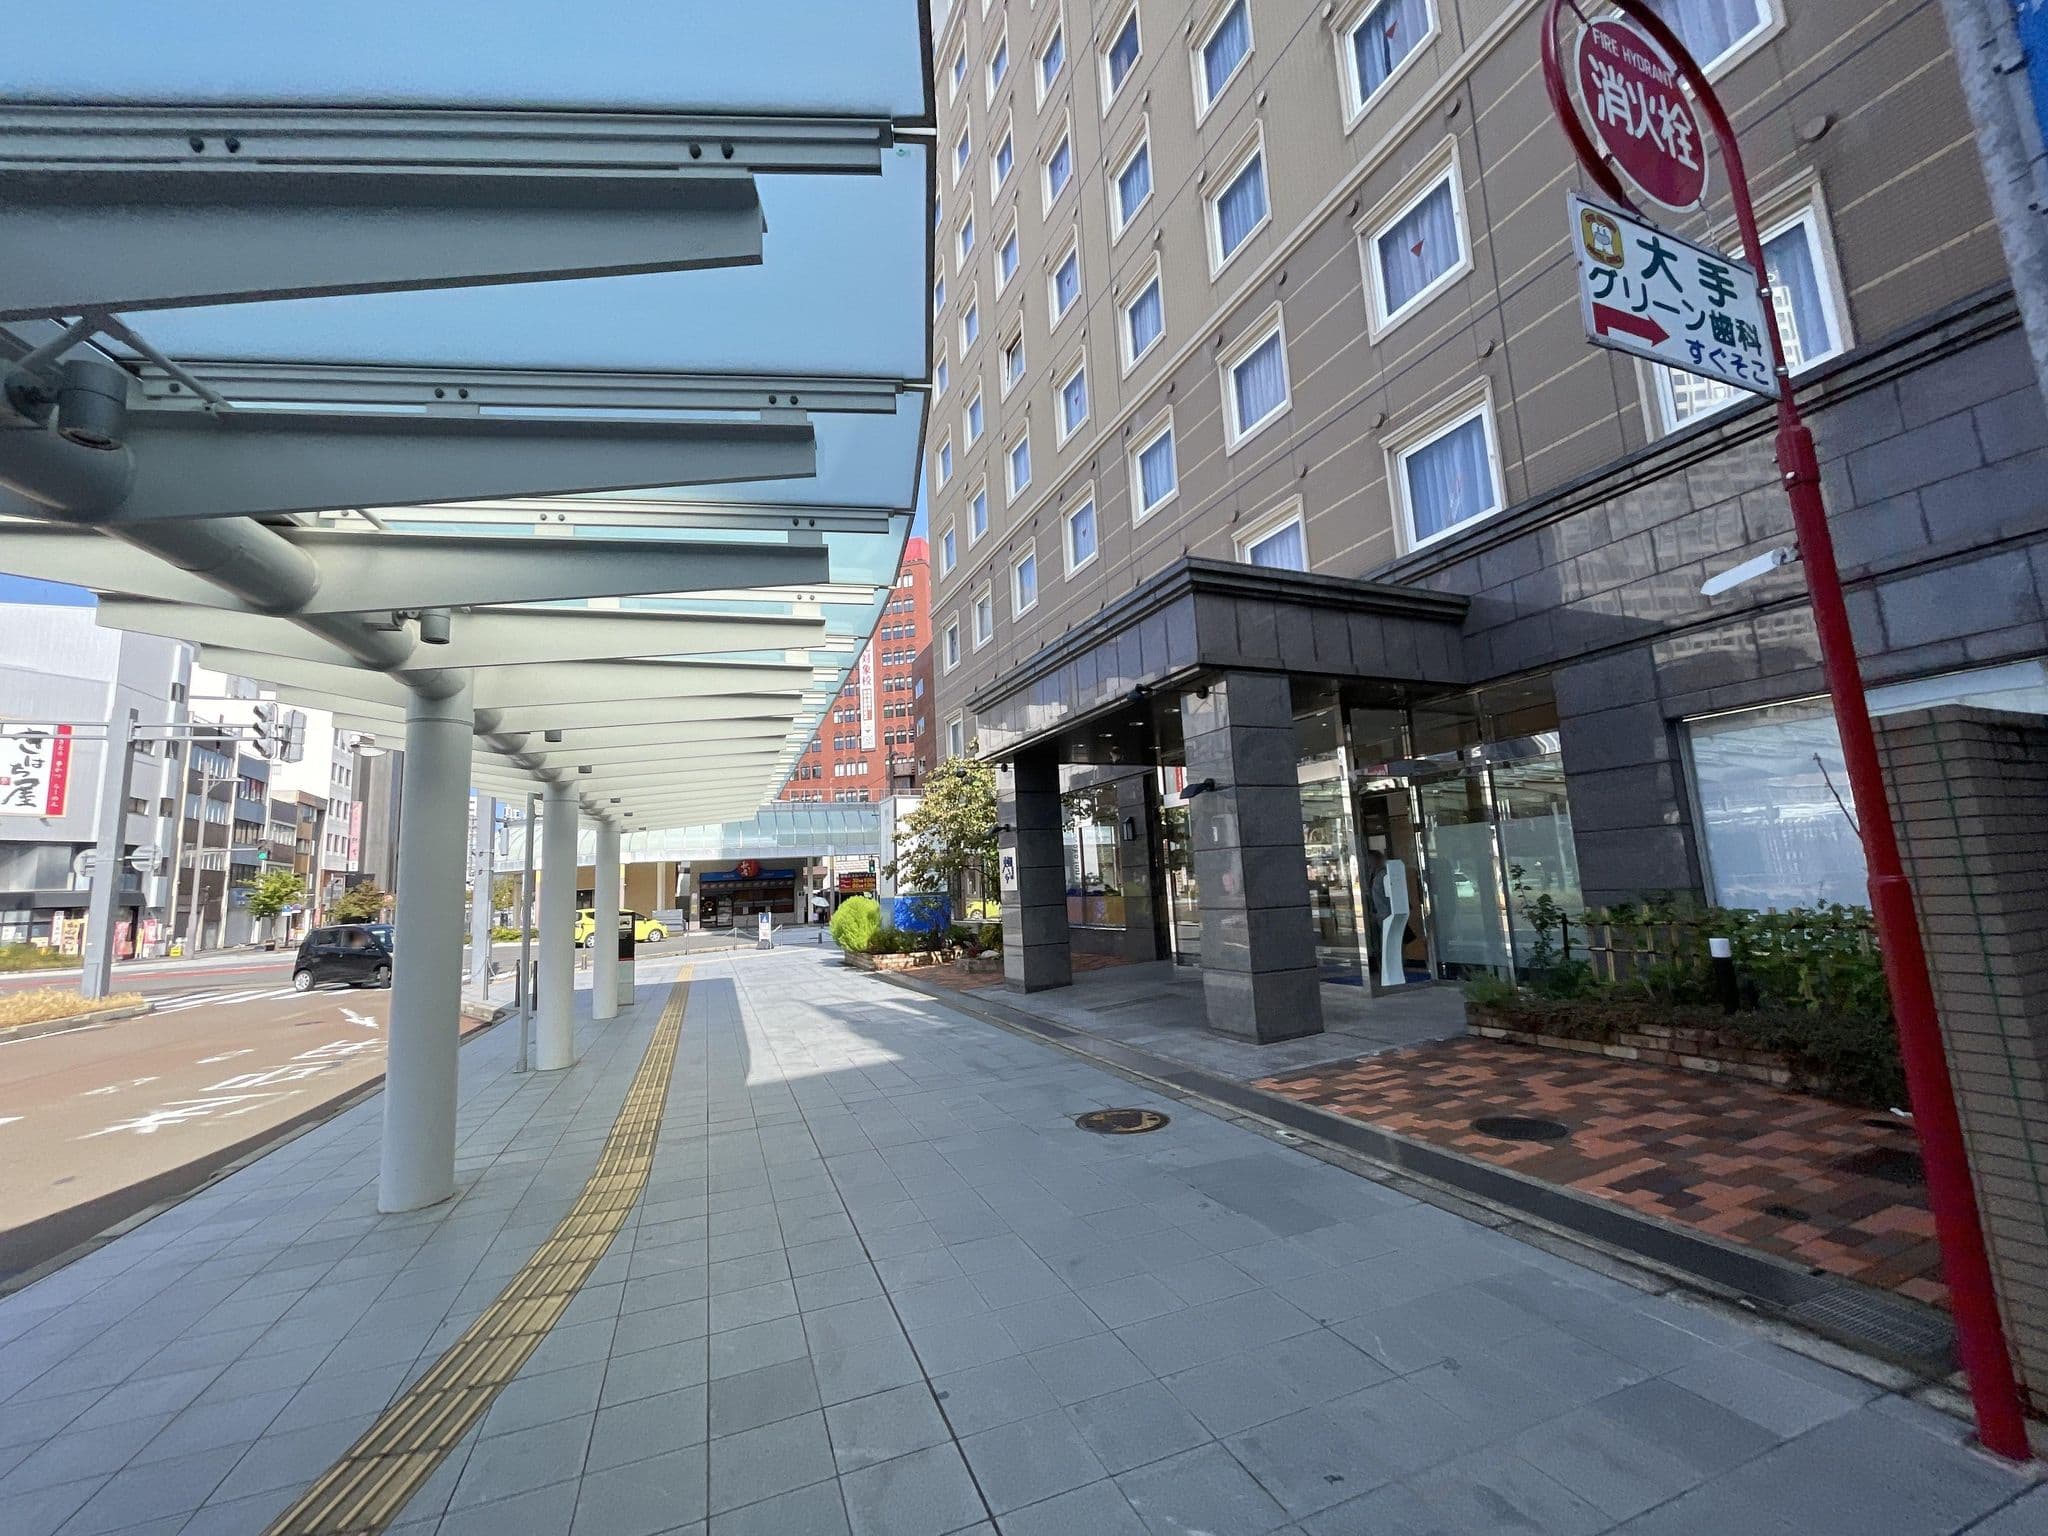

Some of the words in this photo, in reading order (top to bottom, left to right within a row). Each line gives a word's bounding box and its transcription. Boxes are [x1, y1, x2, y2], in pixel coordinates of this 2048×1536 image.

[1592, 29, 1620, 57] FIRE
[1622, 45, 1674, 90] HYDRANT
[1588, 54, 1699, 172] 消火栓
[1636, 236, 1738, 308] 大手
[1589, 266, 1763, 357] グリーン歯科
[1685, 339, 1769, 386] すぐそこ
